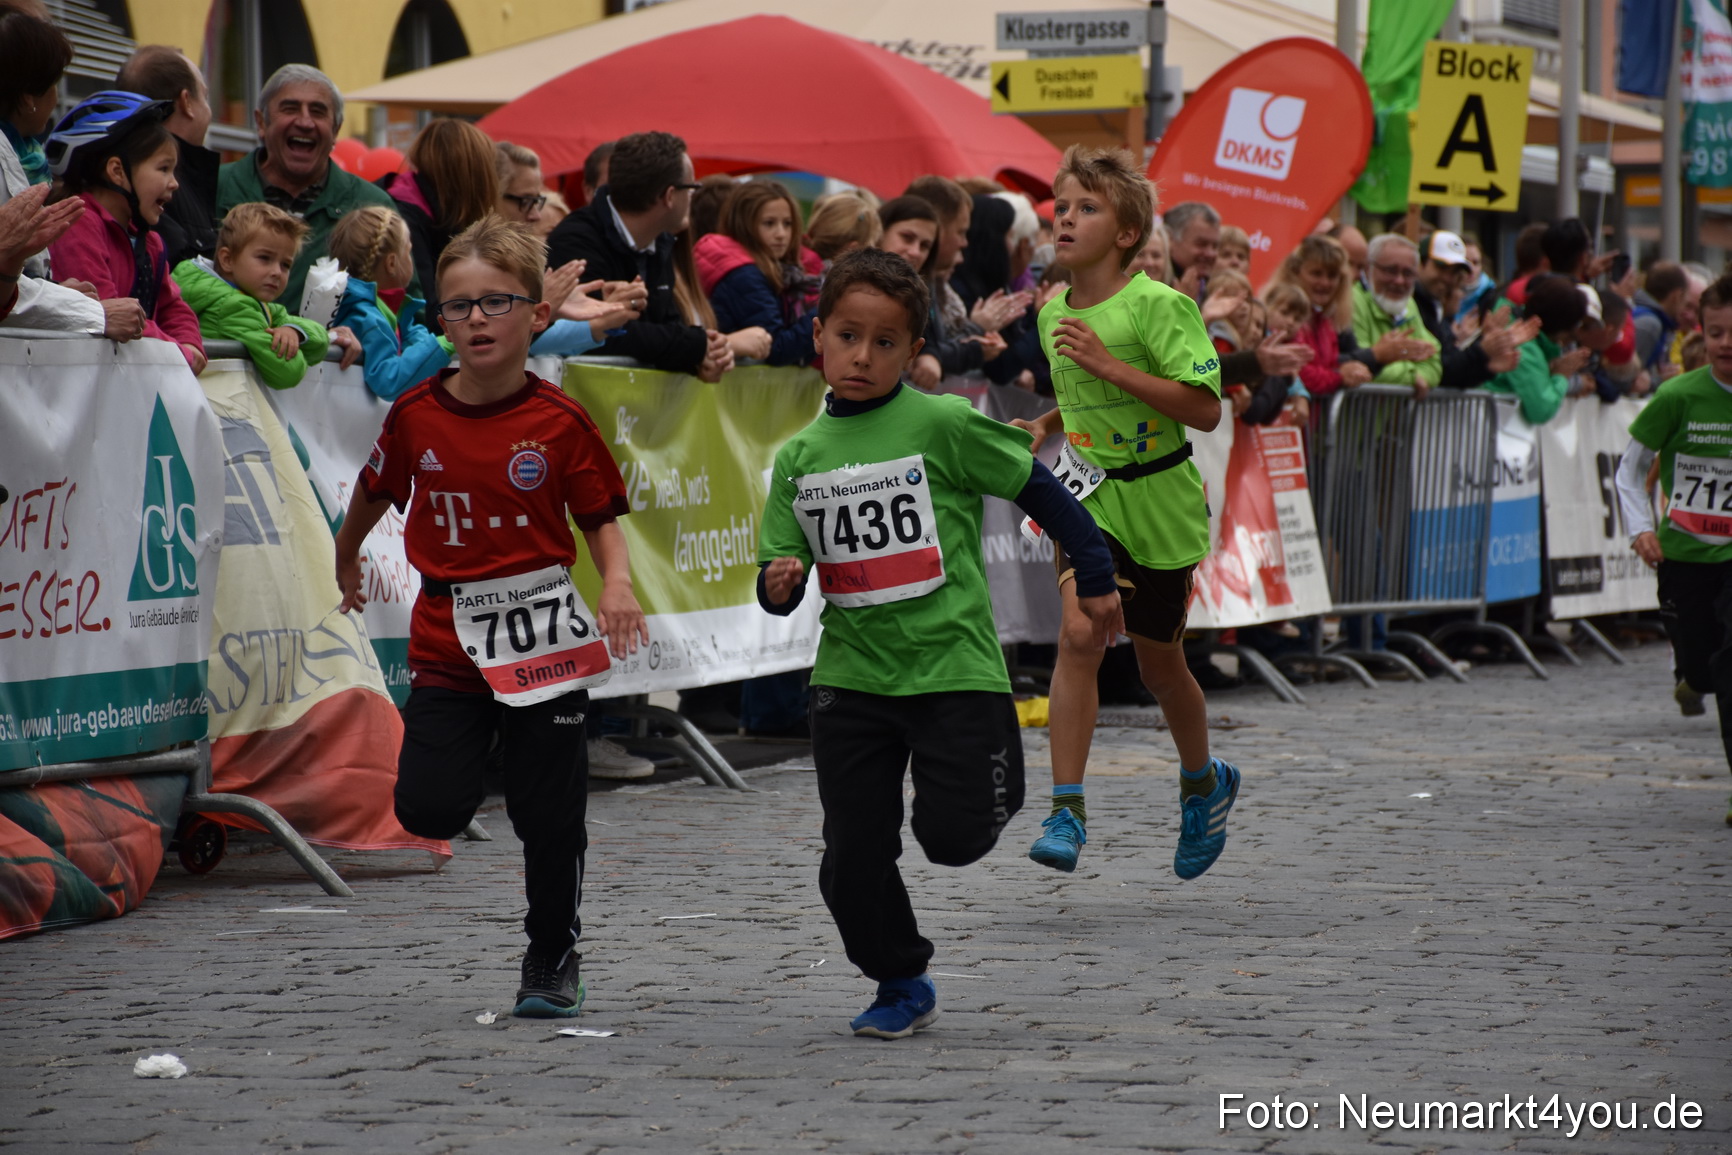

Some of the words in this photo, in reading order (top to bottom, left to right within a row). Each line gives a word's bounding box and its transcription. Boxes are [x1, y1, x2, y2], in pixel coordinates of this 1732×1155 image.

[1005, 19, 1130, 44] Klostergasse
[1035, 69, 1098, 83] Duschen
[1437, 49, 1521, 83] Block
[1040, 86, 1093, 101] Freibad
[1436, 92, 1498, 173] A
[1222, 139, 1286, 170] DKMS
[1183, 172, 1201, 185] Wir
[614, 406, 639, 444] Der
[420, 463, 443, 471] adidas
[1677, 462, 1709, 473] PARTL
[832, 475, 901, 498] Neumarkt
[429, 491, 471, 547] T
[805, 493, 922, 556] 7436
[1702, 520, 1731, 533] Luis
[674, 512, 756, 582] langgeht!
[833, 562, 874, 591] Paul
[456, 592, 505, 609] PARTL
[508, 573, 571, 602] Neumarkt
[129, 611, 146, 629] Jura
[471, 592, 589, 660] 7073
[515, 660, 577, 687] Simon
[553, 715, 580, 724] JAKO
